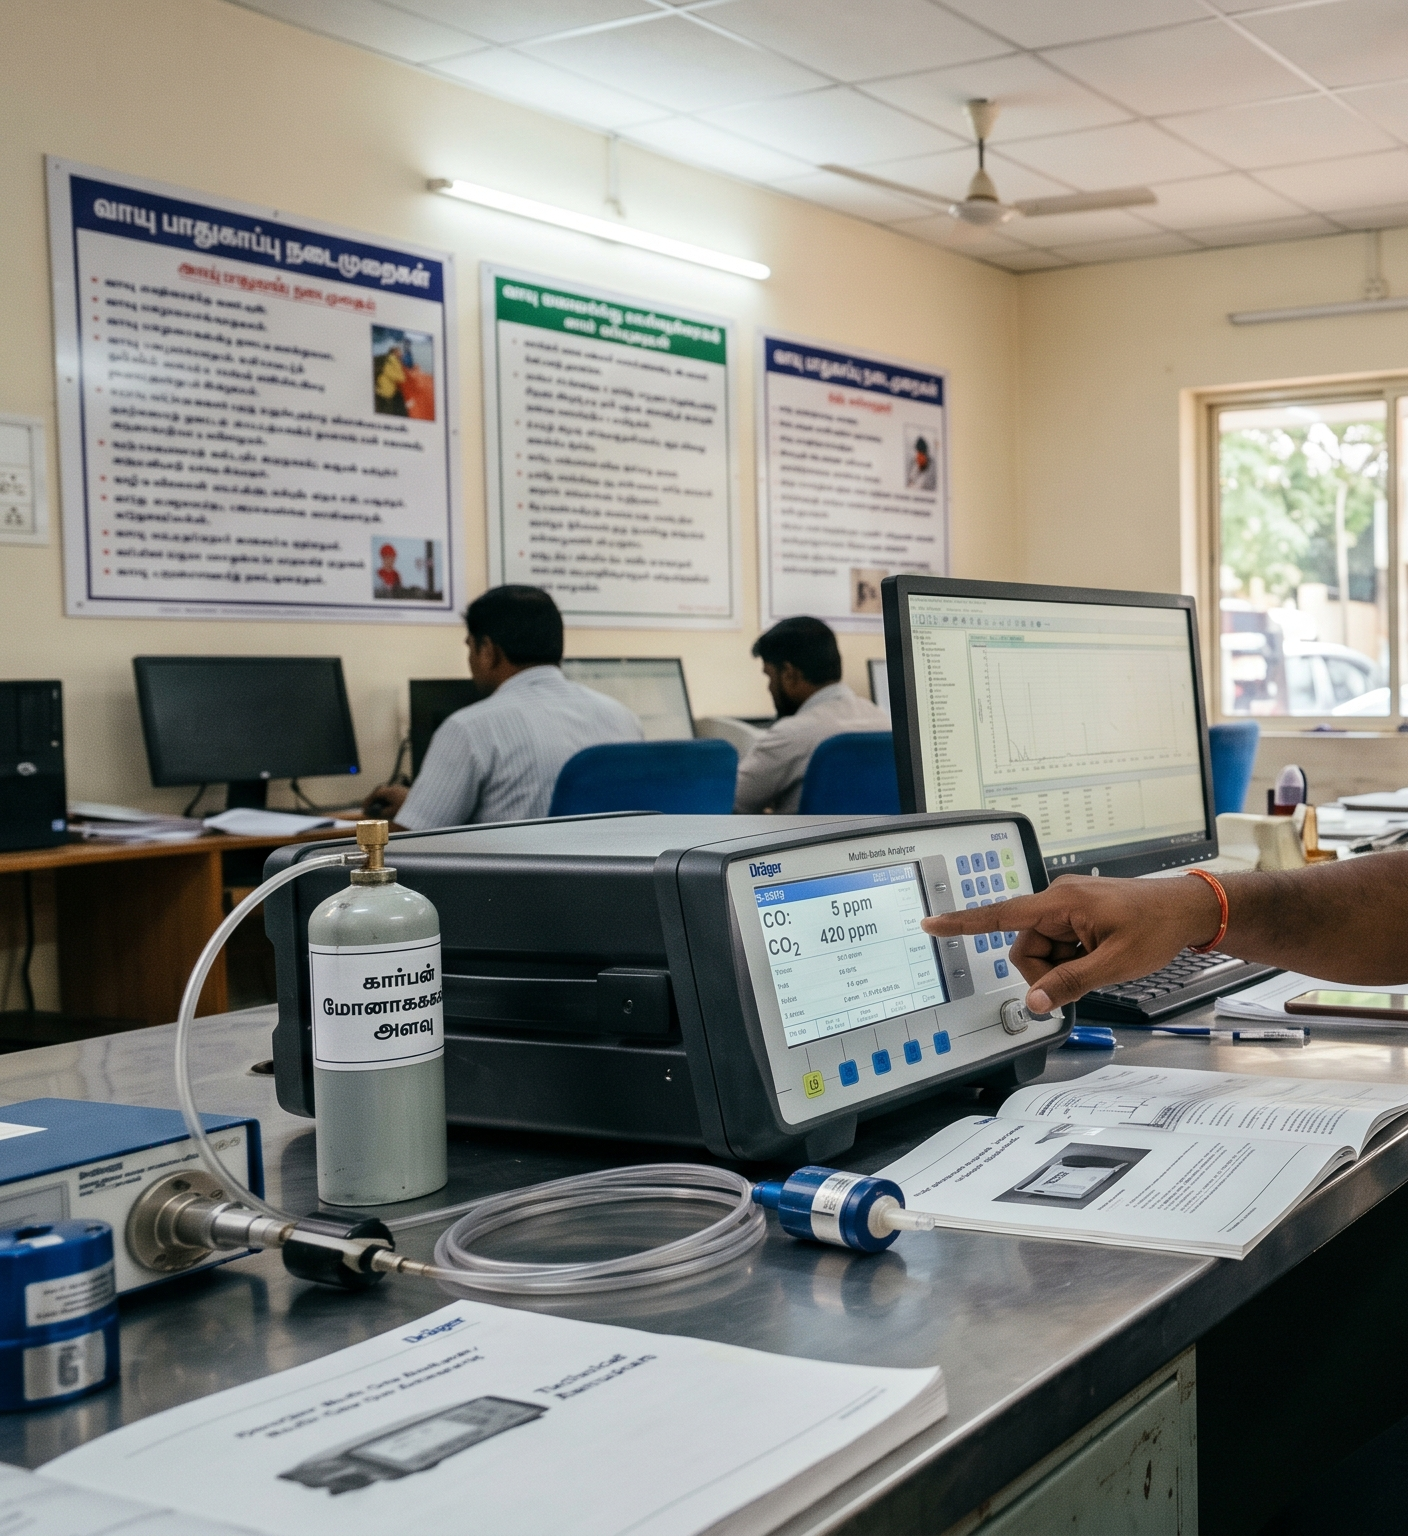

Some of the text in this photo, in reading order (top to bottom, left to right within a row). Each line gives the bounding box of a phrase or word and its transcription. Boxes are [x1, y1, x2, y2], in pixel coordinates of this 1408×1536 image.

[93, 197, 156, 236] வாயு
[161, 213, 281, 263] பாதுகாப்பு
[749, 862, 782, 878] Dräger
[763, 897, 873, 929] CO: 5 ppm
[820, 925, 845, 945] 420
[848, 922, 878, 943] ppm
[363, 963, 435, 990] கார்பன்
[374, 1017, 434, 1040] அளவு
